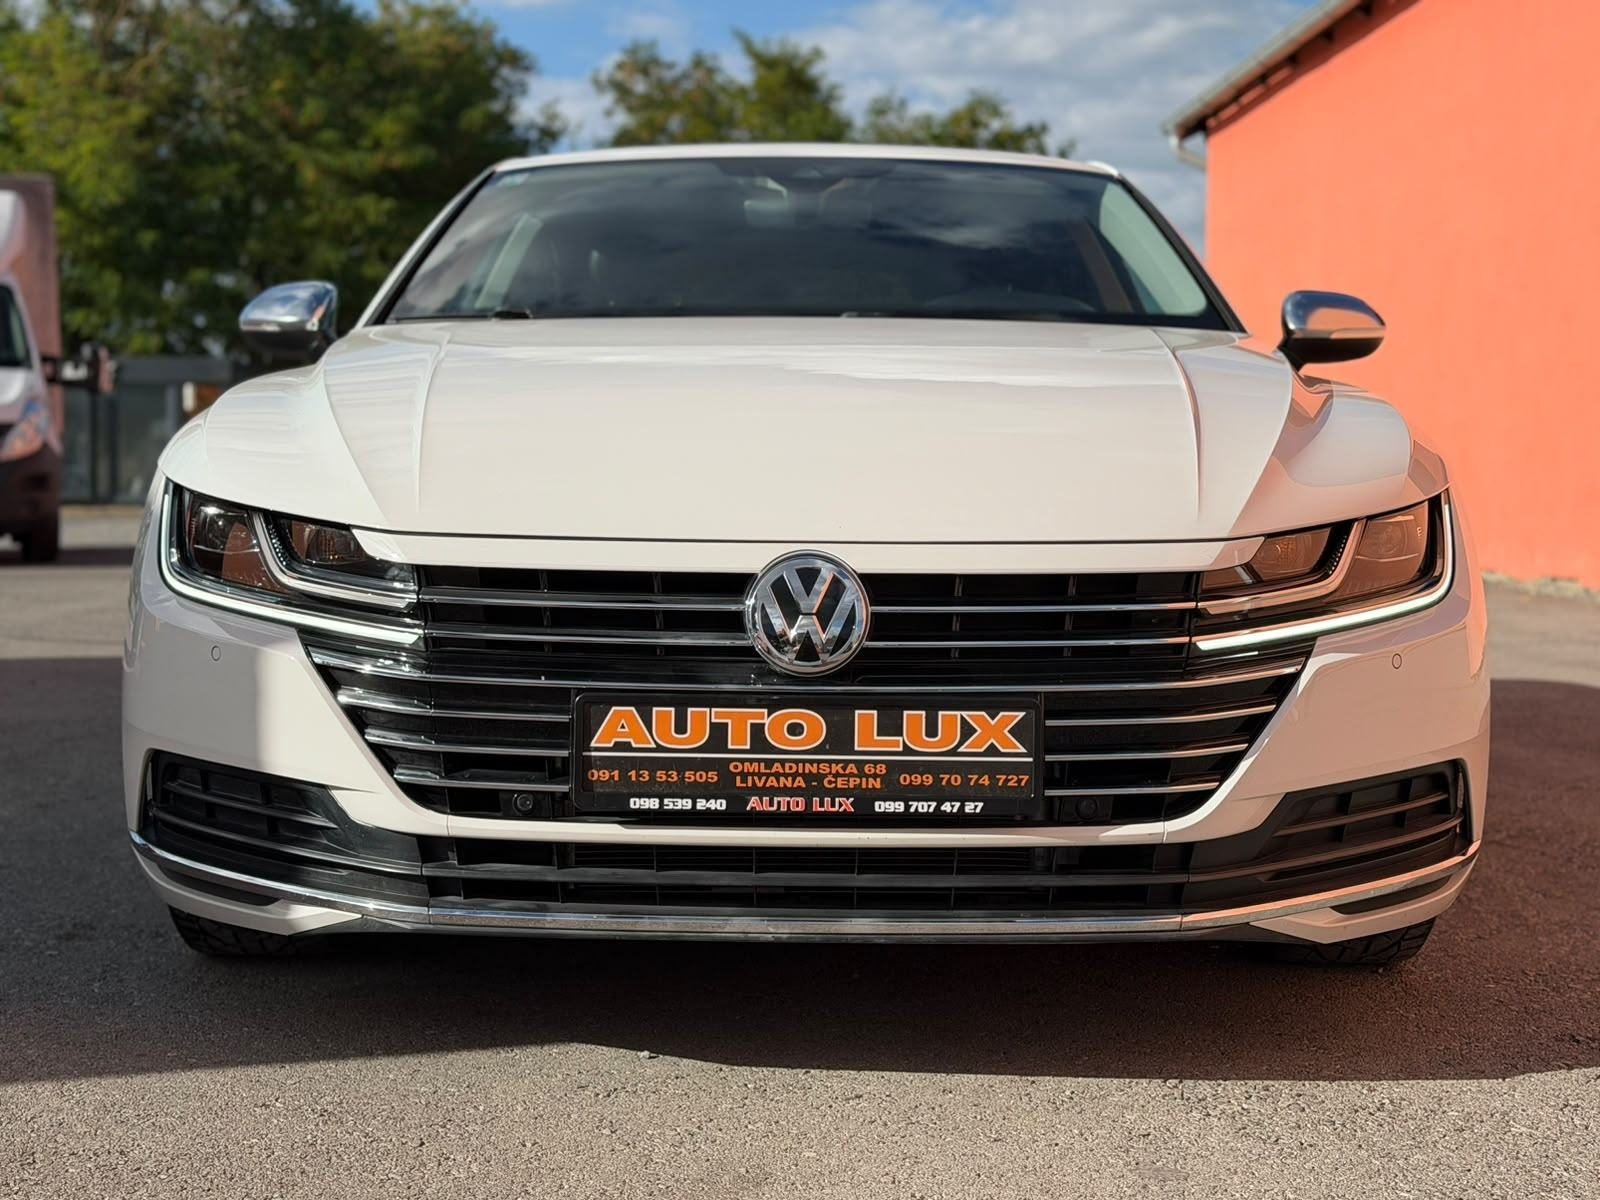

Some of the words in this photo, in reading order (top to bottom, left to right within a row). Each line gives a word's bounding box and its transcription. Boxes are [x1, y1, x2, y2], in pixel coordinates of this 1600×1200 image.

[590, 706, 827, 751] AUTO
[854, 709, 1028, 753] LUX
[728, 761, 858, 774] OMLADINSKA
[864, 763, 887, 775] 68
[587, 769, 620, 782] 091
[627, 770, 650, 782] 13
[655, 770, 678, 783] 53
[683, 770, 719, 783] 505
[735, 775, 807, 788] LIVANA
[823, 775, 882, 789] ČEPIN
[899, 773, 934, 786] 099
[939, 774, 962, 787] 70
[967, 774, 991, 787] 74
[995, 775, 1030, 787] 727
[629, 797, 660, 810] 098
[663, 797, 692, 810] 539
[696, 798, 727, 811] 240
[746, 796, 806, 811] AUTO
[812, 797, 855, 812] LUX
[874, 801, 905, 813] 099
[908, 801, 937, 813] 707
[940, 801, 964, 813] 47
[964, 802, 984, 814] 27
